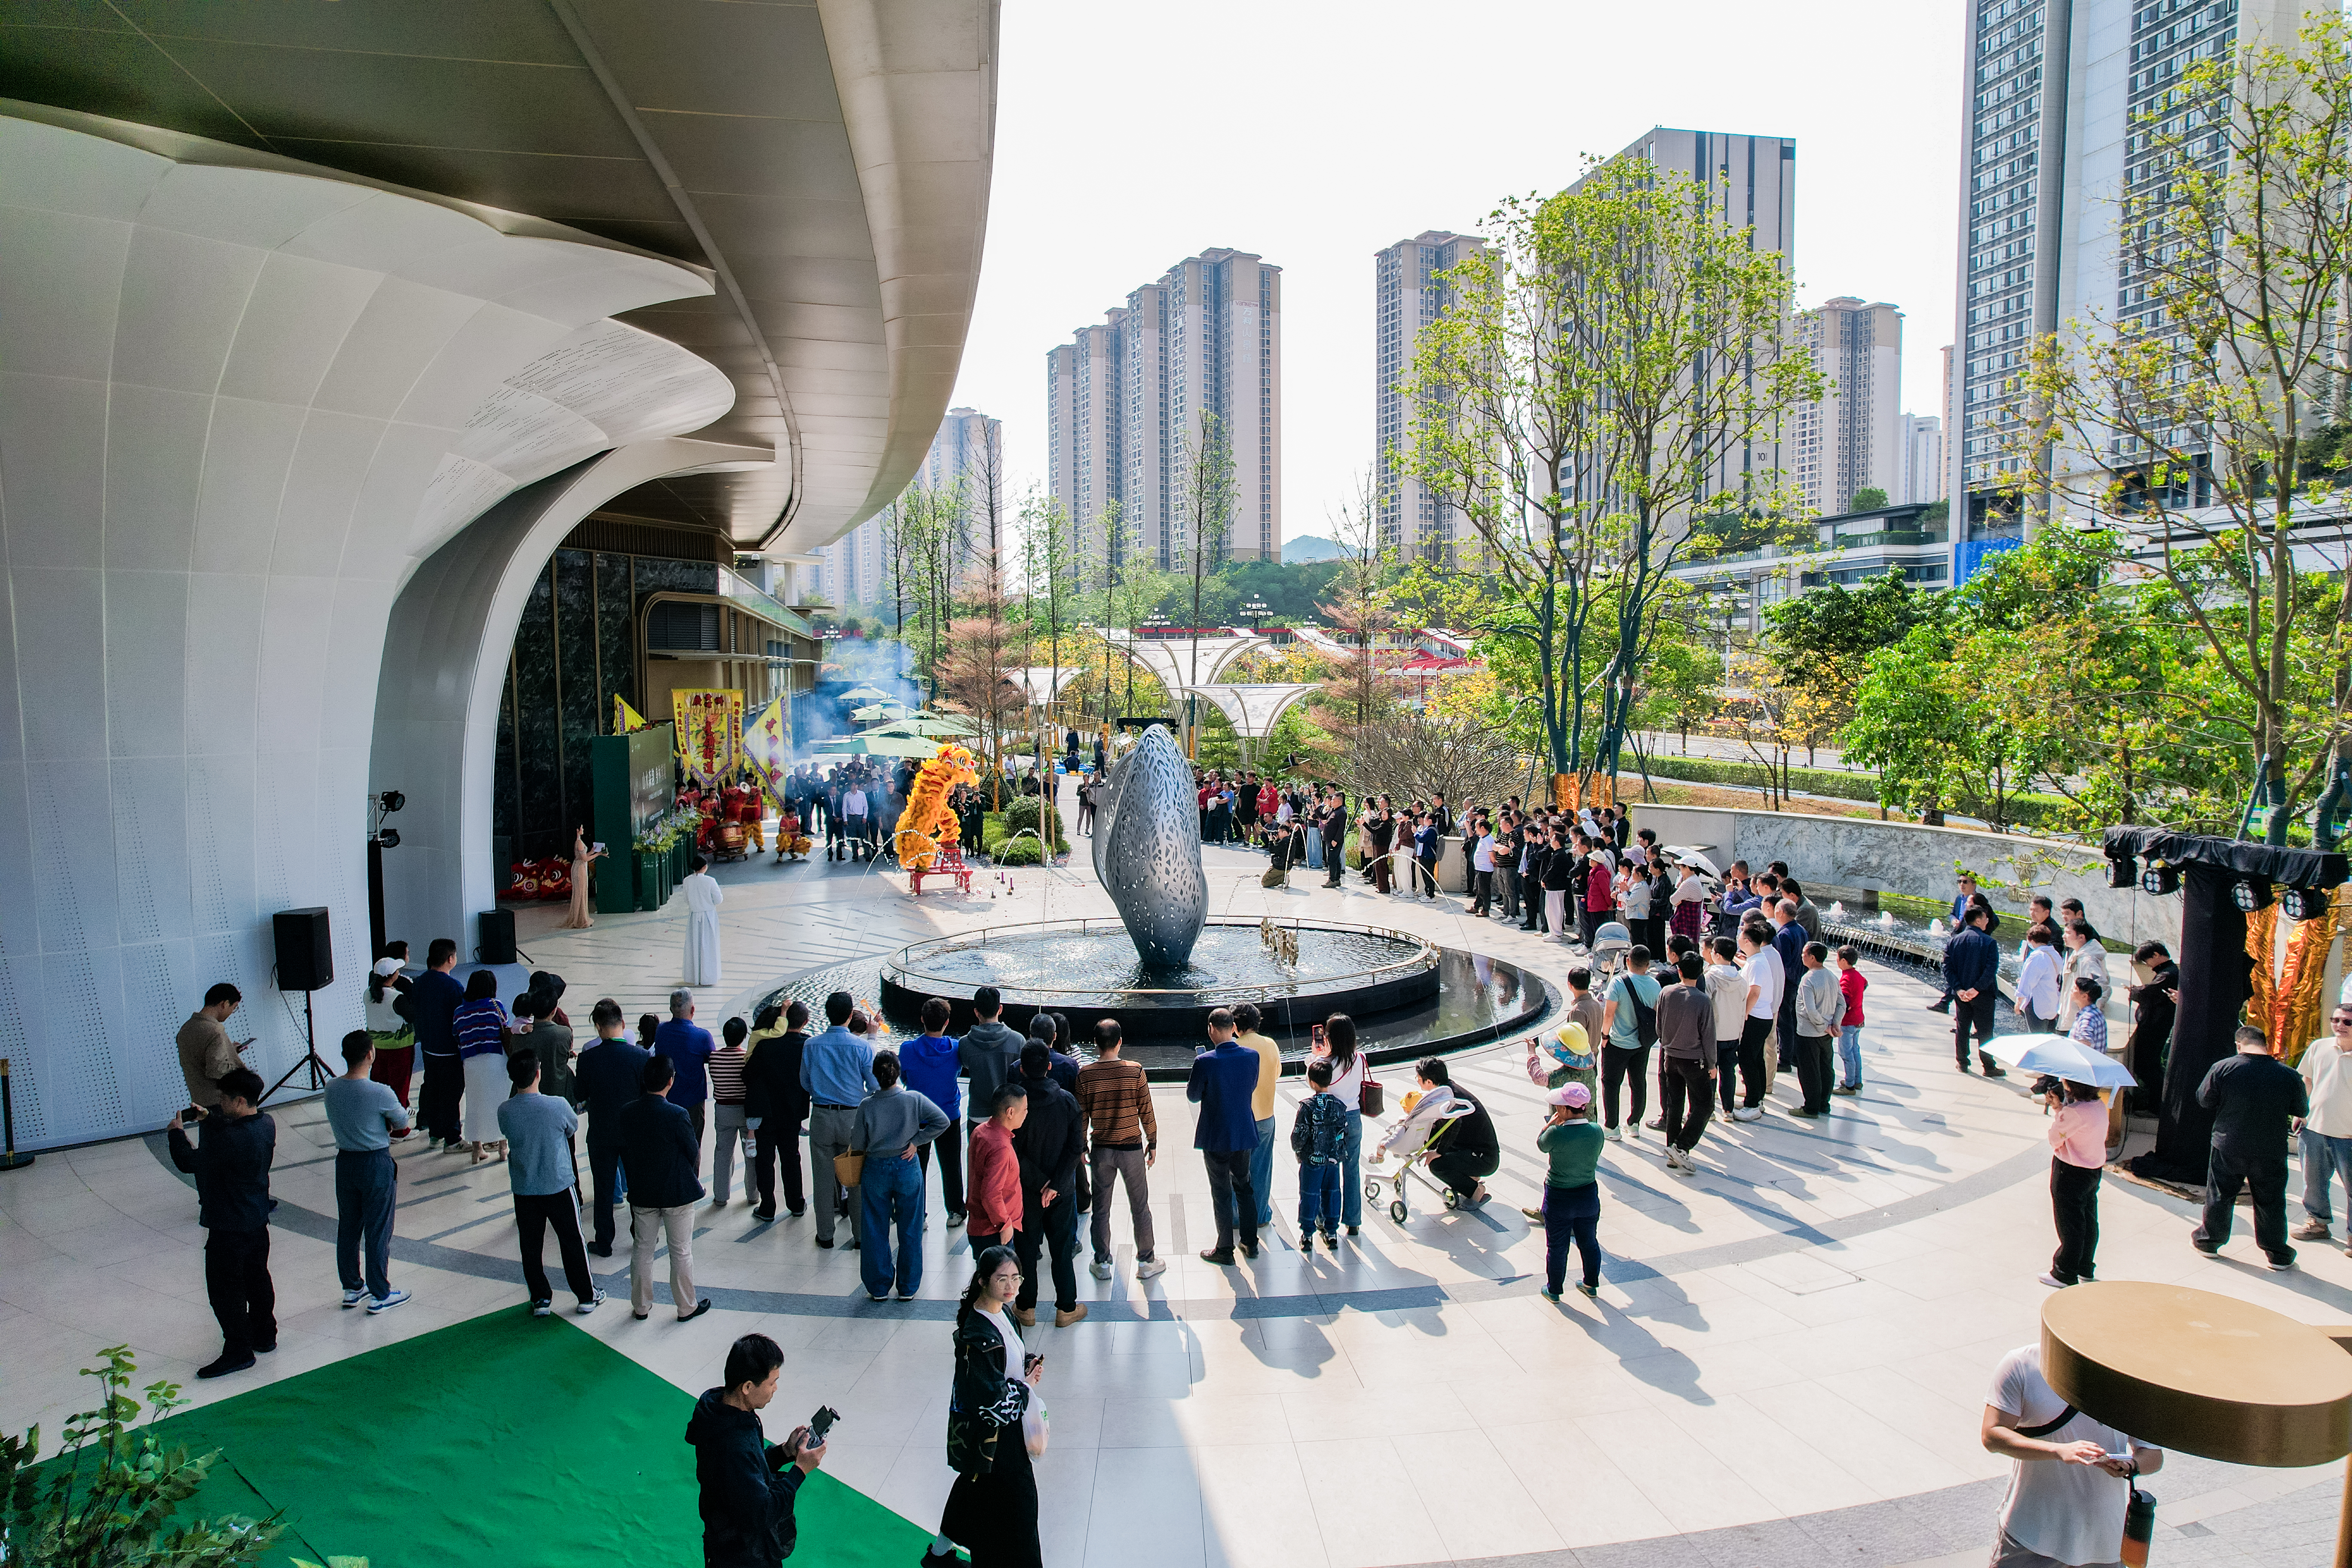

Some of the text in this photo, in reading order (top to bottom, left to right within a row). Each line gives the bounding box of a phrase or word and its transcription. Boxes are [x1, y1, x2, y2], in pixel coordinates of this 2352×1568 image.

[1243, 308, 1252, 363] 万科山景城
[1758, 453, 1765, 461] 10
